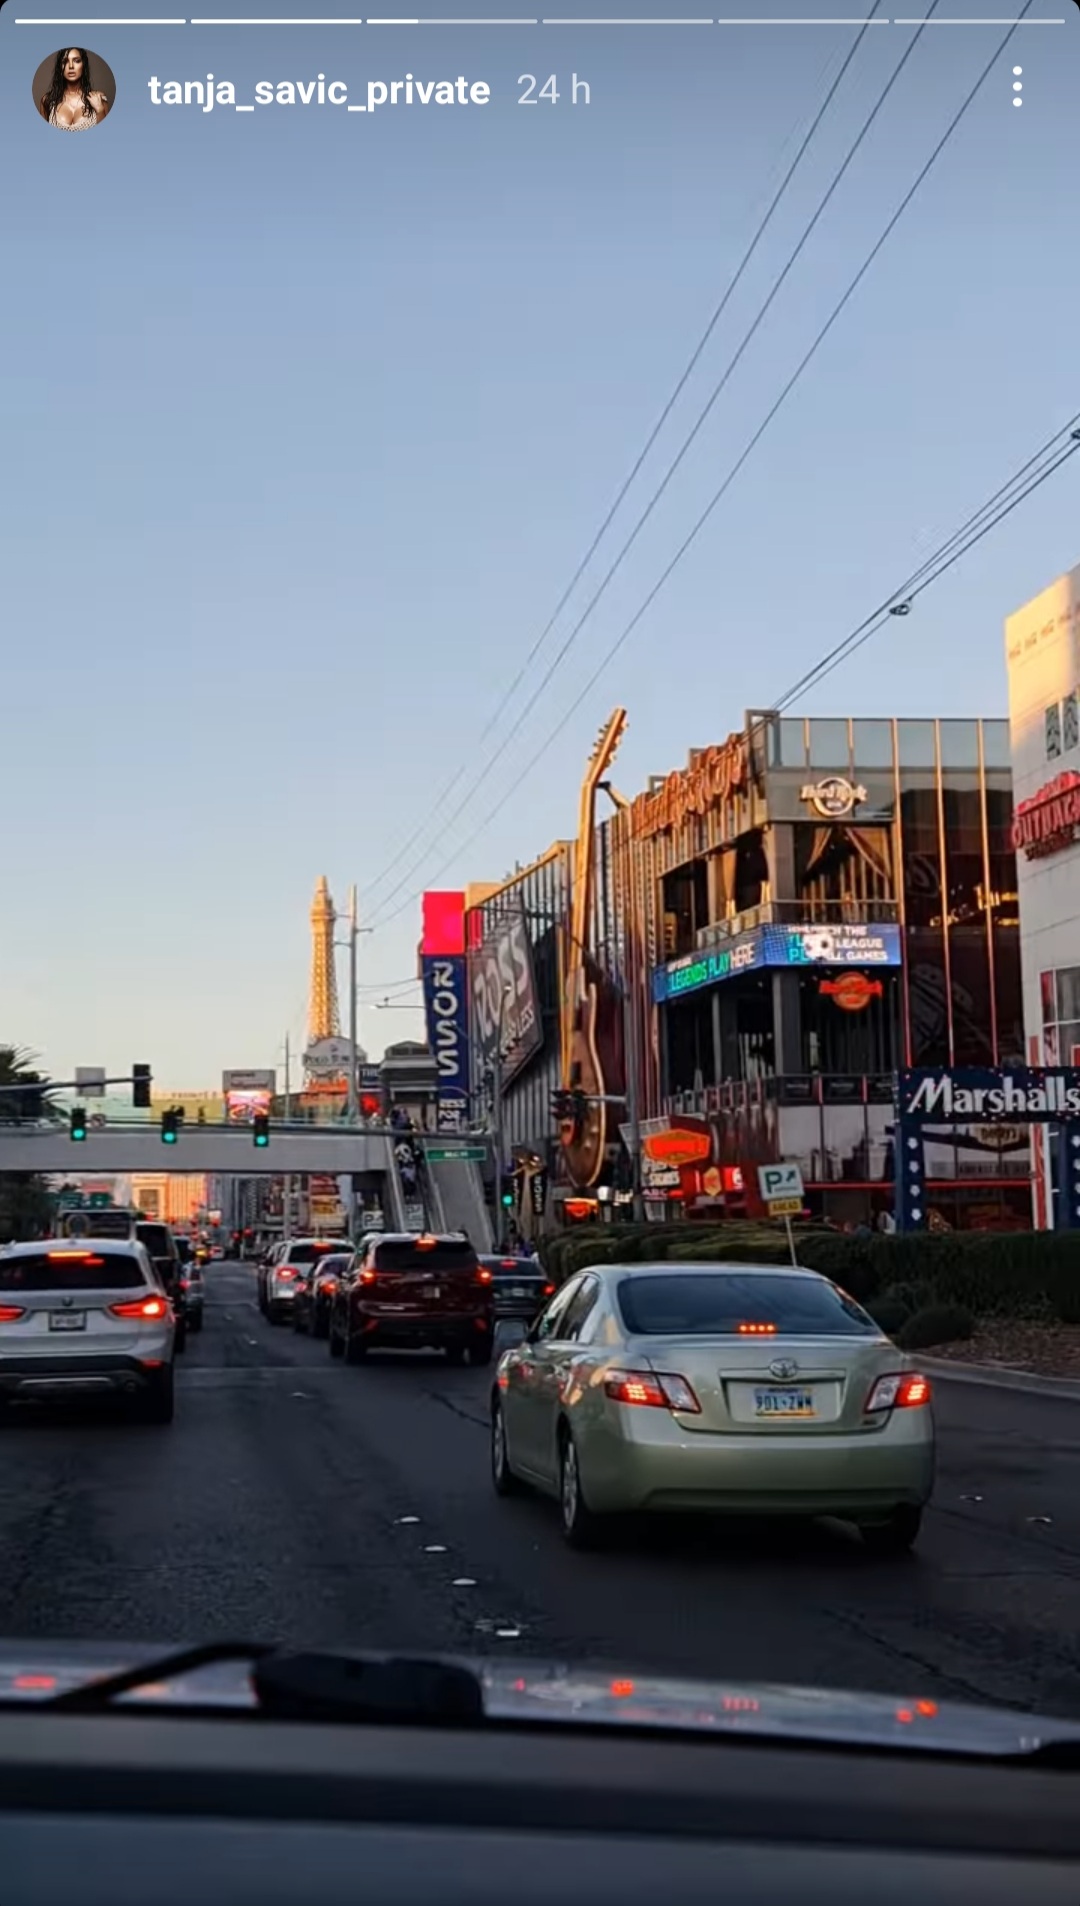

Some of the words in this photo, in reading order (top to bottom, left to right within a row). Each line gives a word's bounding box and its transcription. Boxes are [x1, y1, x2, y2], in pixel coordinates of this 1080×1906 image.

[835, 938, 883, 949] LEAGUE
[846, 950, 888, 961] GAMES
[730, 943, 755, 970] HERE
[433, 962, 460, 1076] ROSS
[907, 1073, 1080, 1113] Marshalls
[765, 1171, 782, 1194] P
